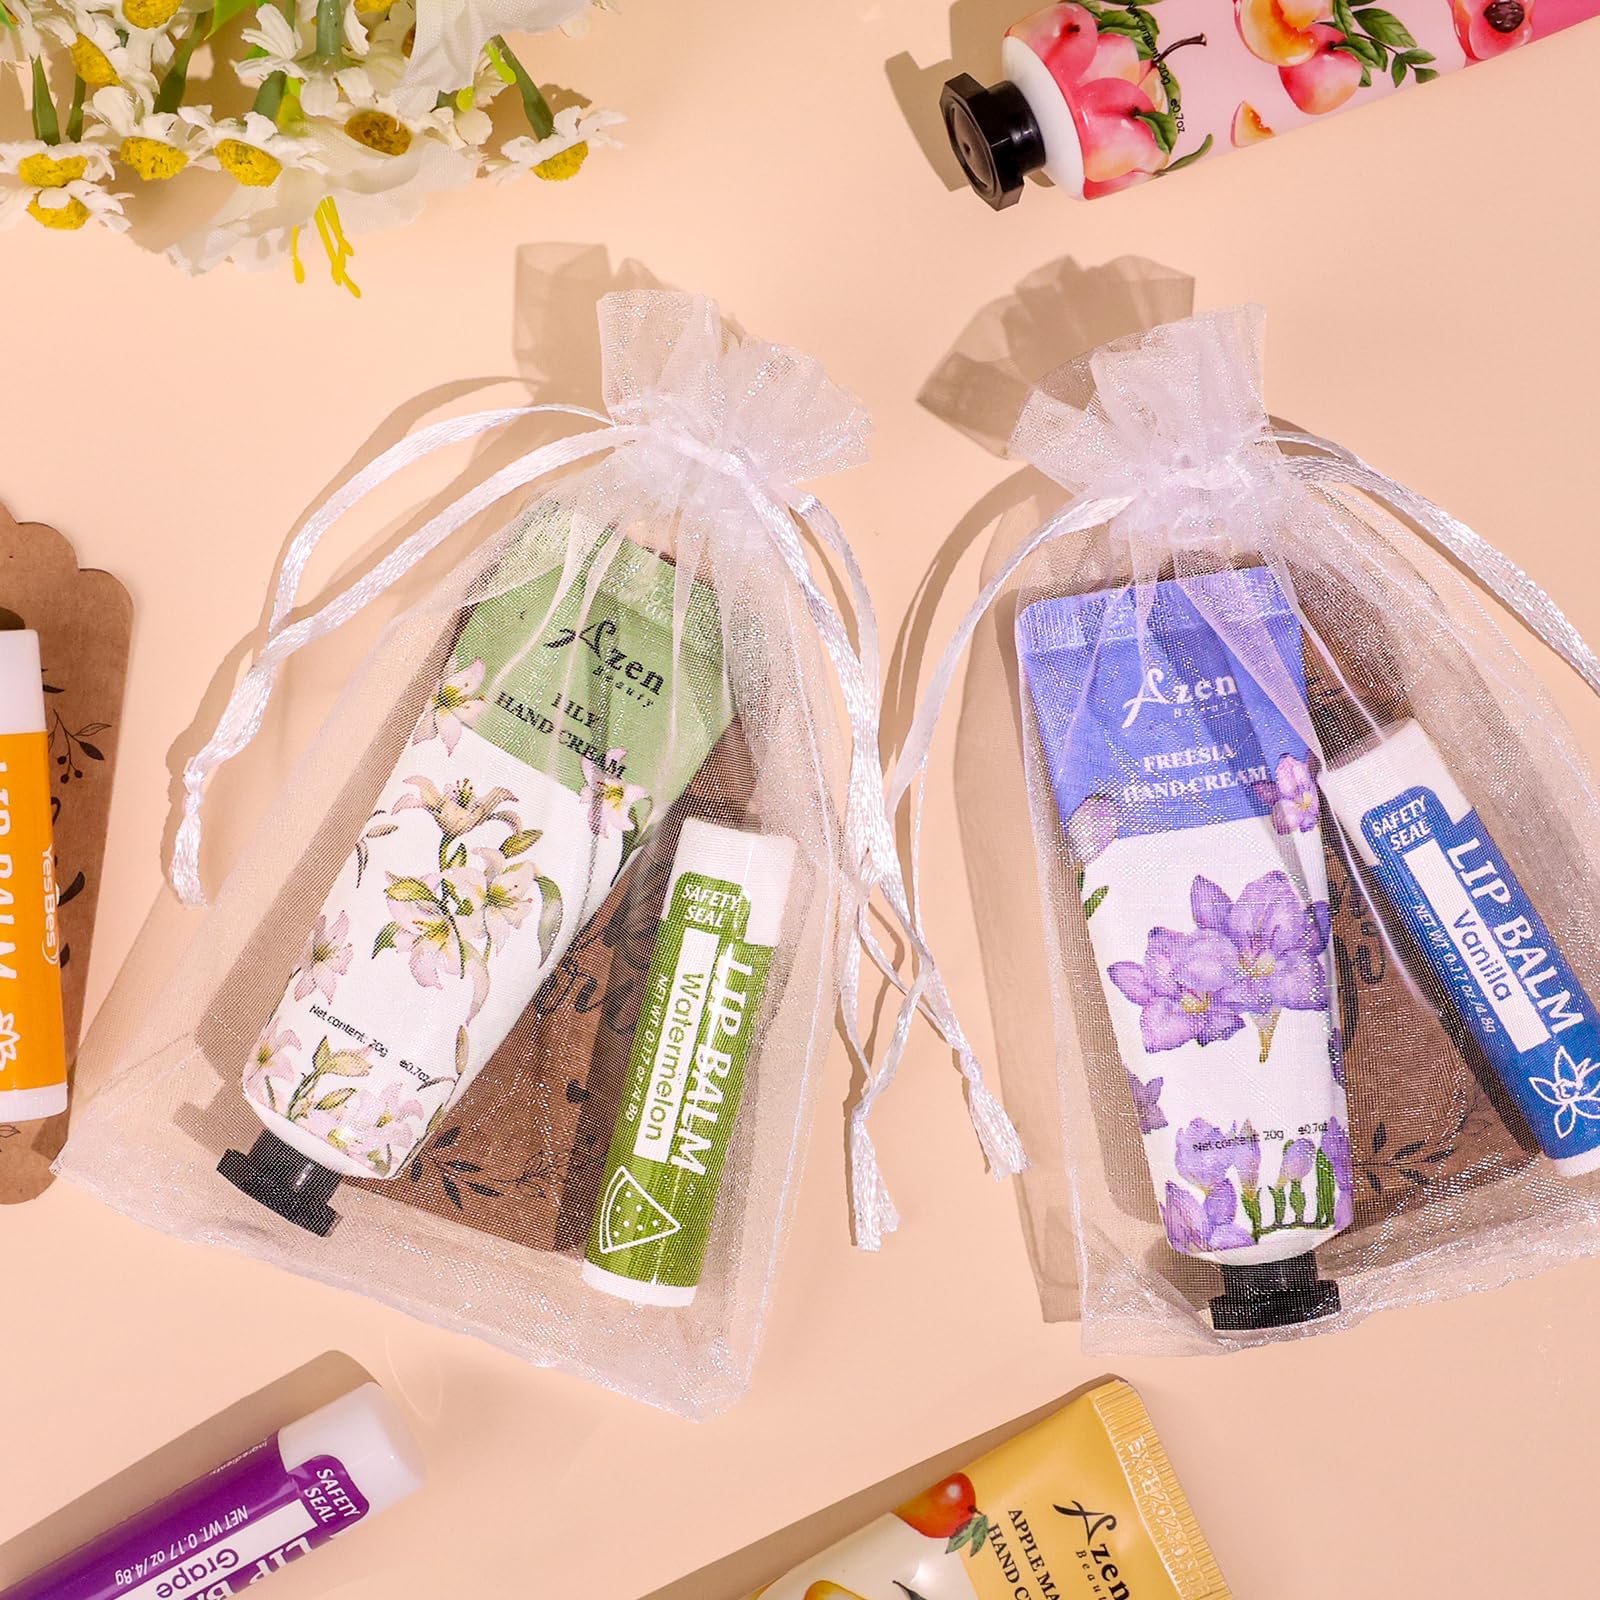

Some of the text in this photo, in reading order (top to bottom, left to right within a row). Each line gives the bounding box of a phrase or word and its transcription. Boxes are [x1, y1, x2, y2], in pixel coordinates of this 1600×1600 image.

[543, 619, 664, 695] Azen
[1121, 668, 1238, 729] Azen
[495, 692, 627, 780] HAND CREAM
[1143, 744, 1237, 772] FREESIA
[1372, 795, 1426, 837] SAFETY
[1390, 820, 1432, 851] SEAL
[682, 884, 741, 911] SAFETY
[684, 905, 724, 928] SEAL
[1447, 838, 1584, 1034] LIP BALM
[1453, 909, 1512, 1001] Vanilla
[309, 1004, 327, 1020] Net
[368, 1039, 388, 1058] 20g
[645, 973, 704, 1141] Watermelon
[671, 958, 753, 1175] LIP BALM
[1263, 1130, 1284, 1140] 20g
[225, 1505, 249, 1530] NET
[304, 1487, 337, 1523] SEAL
[316, 1468, 360, 1518] SAFETY
[170, 1533, 198, 1560] 0.17
[987, 1524, 1020, 1583] HAND
[1008, 1509, 1042, 1571] APPLE
[1053, 1500, 1130, 1600] Azen
[156, 1549, 239, 1598] Grape
